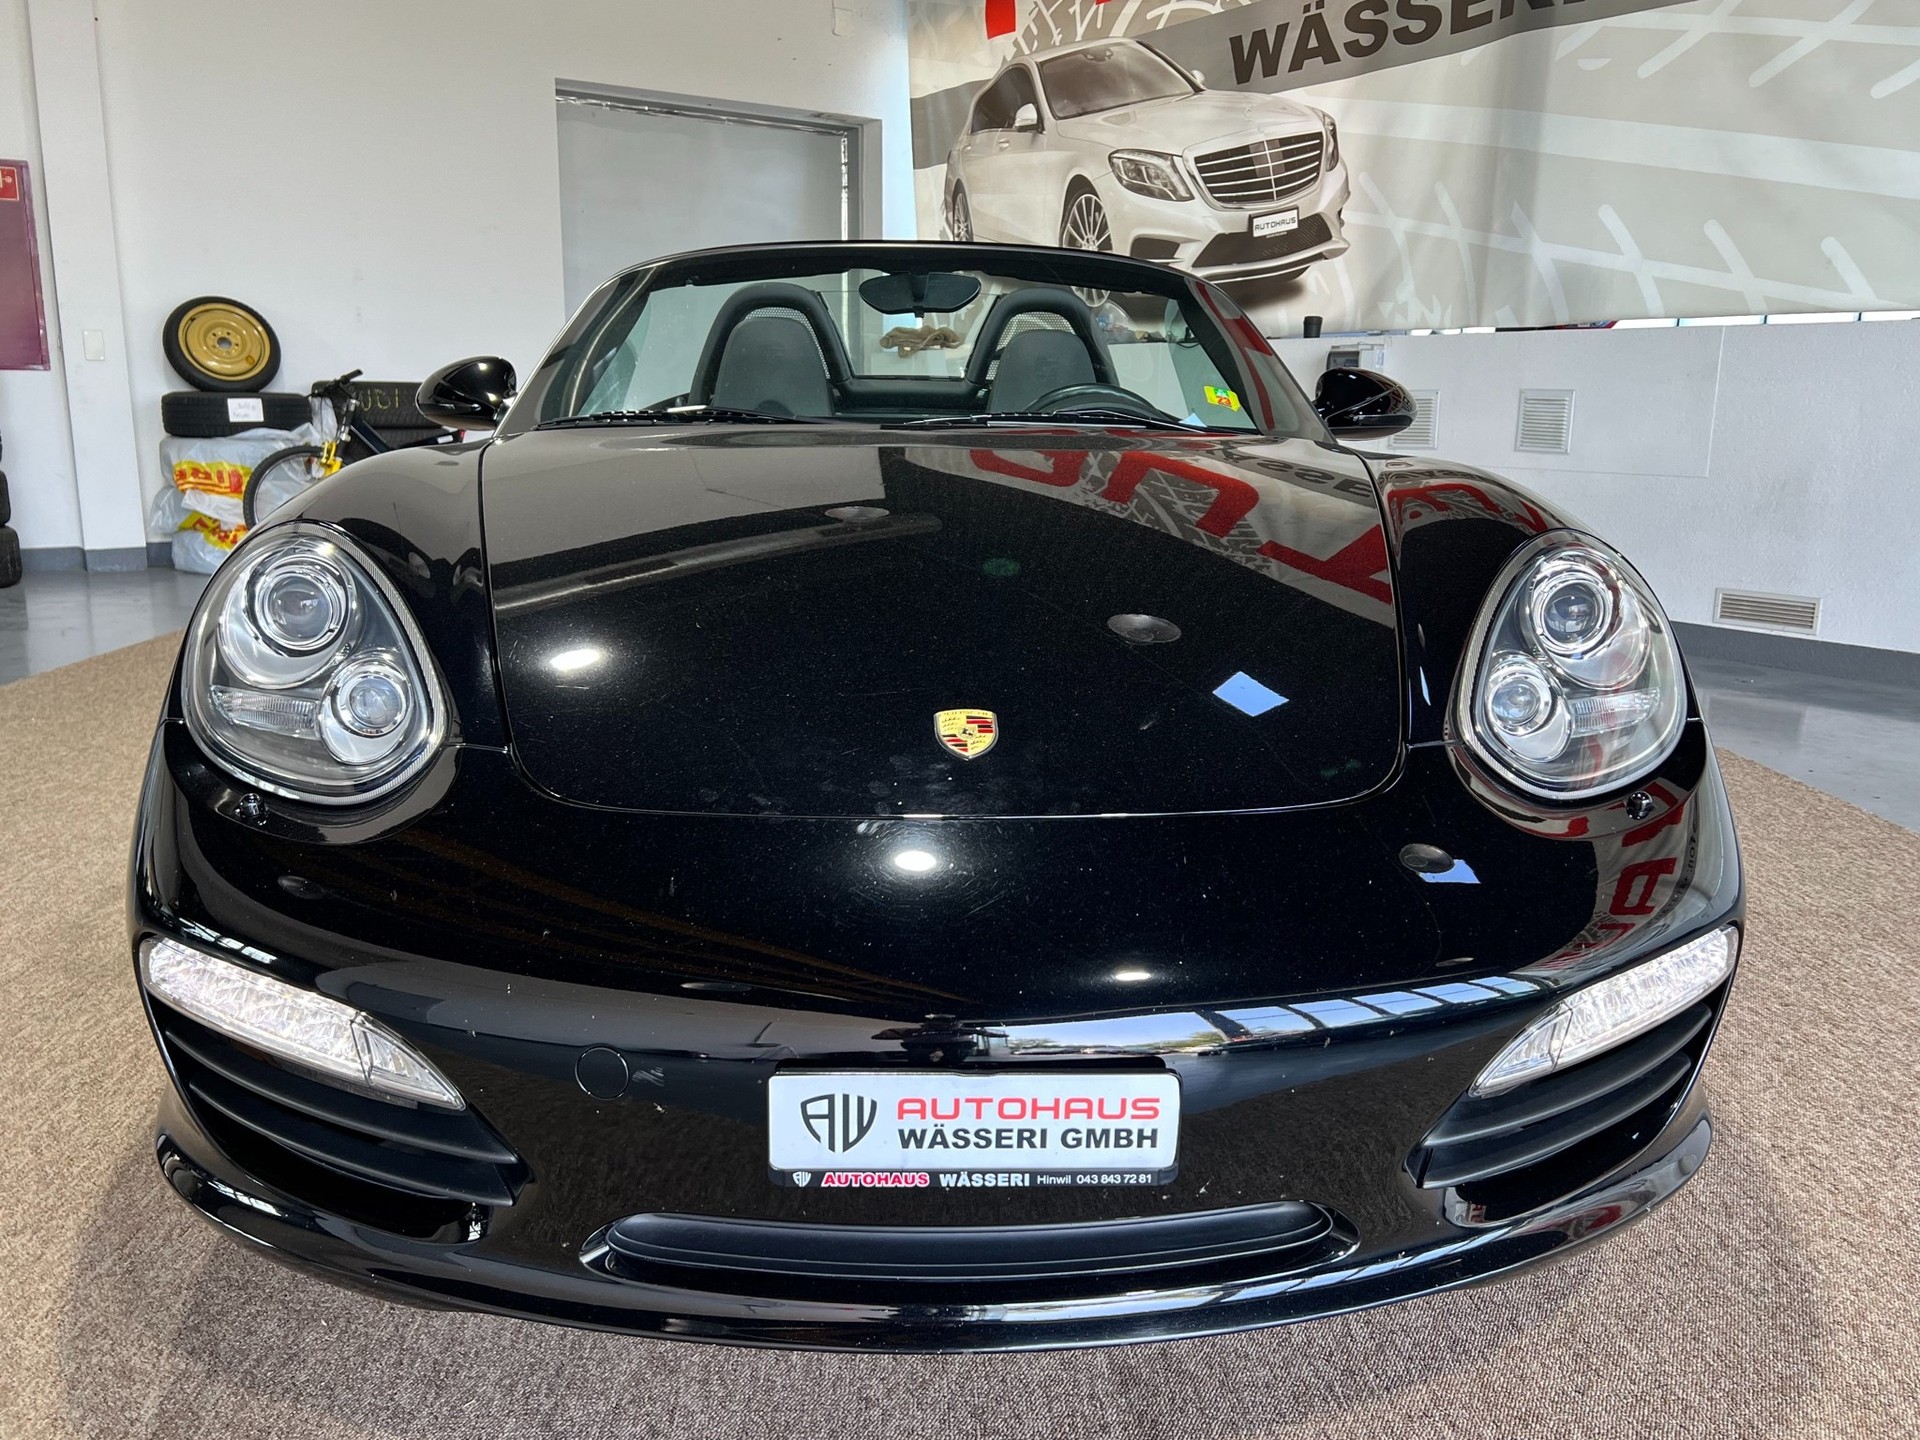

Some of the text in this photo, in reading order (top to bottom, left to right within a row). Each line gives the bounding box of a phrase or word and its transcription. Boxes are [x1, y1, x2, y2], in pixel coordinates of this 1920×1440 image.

[1229, 0, 1586, 85] WÄSSE
[1254, 217, 1296, 231] AUTOHAUS
[898, 1098, 1160, 1120] AUTOHAUS
[898, 1123, 1159, 1149] WÄSSERI GMBH
[821, 1172, 930, 1187] AUTOHAUS
[939, 1171, 1030, 1187] WÄSSERI
[1037, 1174, 1072, 1185] Hinwil
[1076, 1174, 1099, 1184] 043
[1101, 1174, 1121, 1184] 843
[1123, 1174, 1137, 1184] 72
[1138, 1174, 1151, 1184] 81
